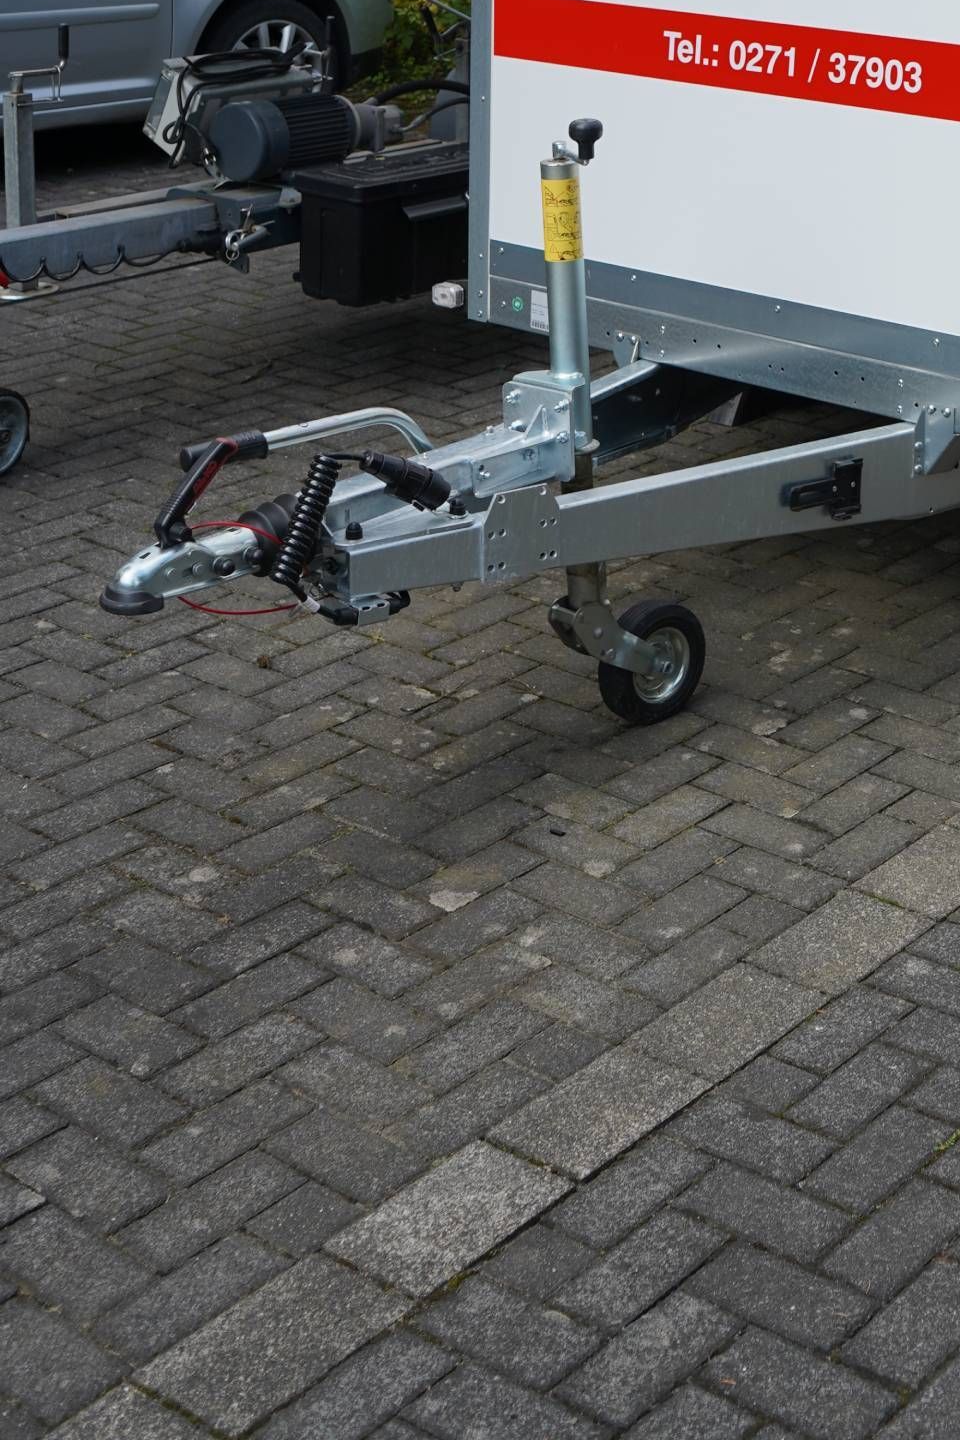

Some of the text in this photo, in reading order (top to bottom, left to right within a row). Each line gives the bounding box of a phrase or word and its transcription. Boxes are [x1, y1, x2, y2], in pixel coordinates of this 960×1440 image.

[663, 30, 719, 67] Tel.:
[729, 40, 796, 77] 0271
[828, 52, 922, 94] 37903
